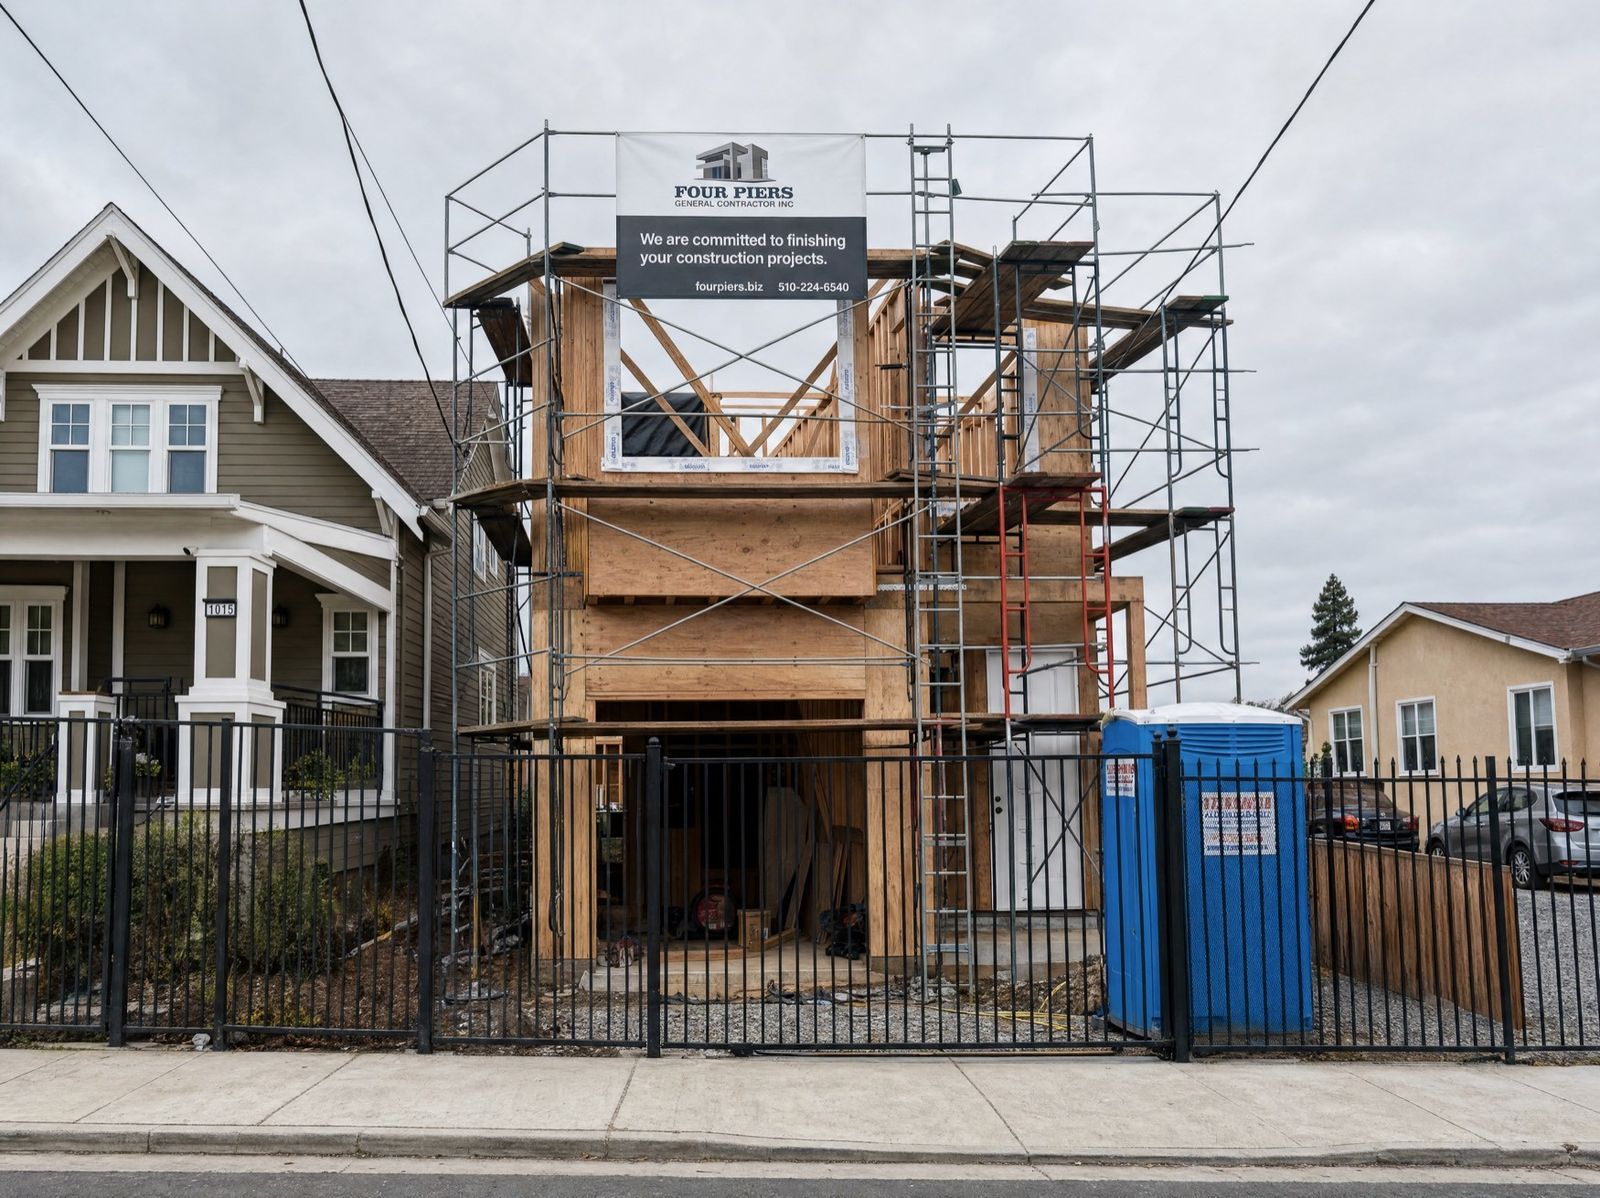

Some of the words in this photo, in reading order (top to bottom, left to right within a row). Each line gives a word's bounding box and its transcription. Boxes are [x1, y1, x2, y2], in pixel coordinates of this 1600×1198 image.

[674, 186, 728, 199] FOUR
[733, 186, 794, 199] PIERS
[674, 200, 715, 208] GENERAL
[716, 200, 776, 208] CONTRACTOR
[778, 200, 794, 208] INC
[640, 232, 664, 246] We
[666, 236, 689, 246] are
[692, 233, 767, 247] committed
[770, 234, 784, 247] to
[786, 233, 846, 249] finishing
[640, 254, 673, 267] your
[676, 251, 764, 265] construction
[767, 252, 827, 268] projects.
[695, 281, 764, 294] fourpiers.biz
[778, 282, 849, 292] 510-224-6540
[209, 604, 233, 615] 1015
